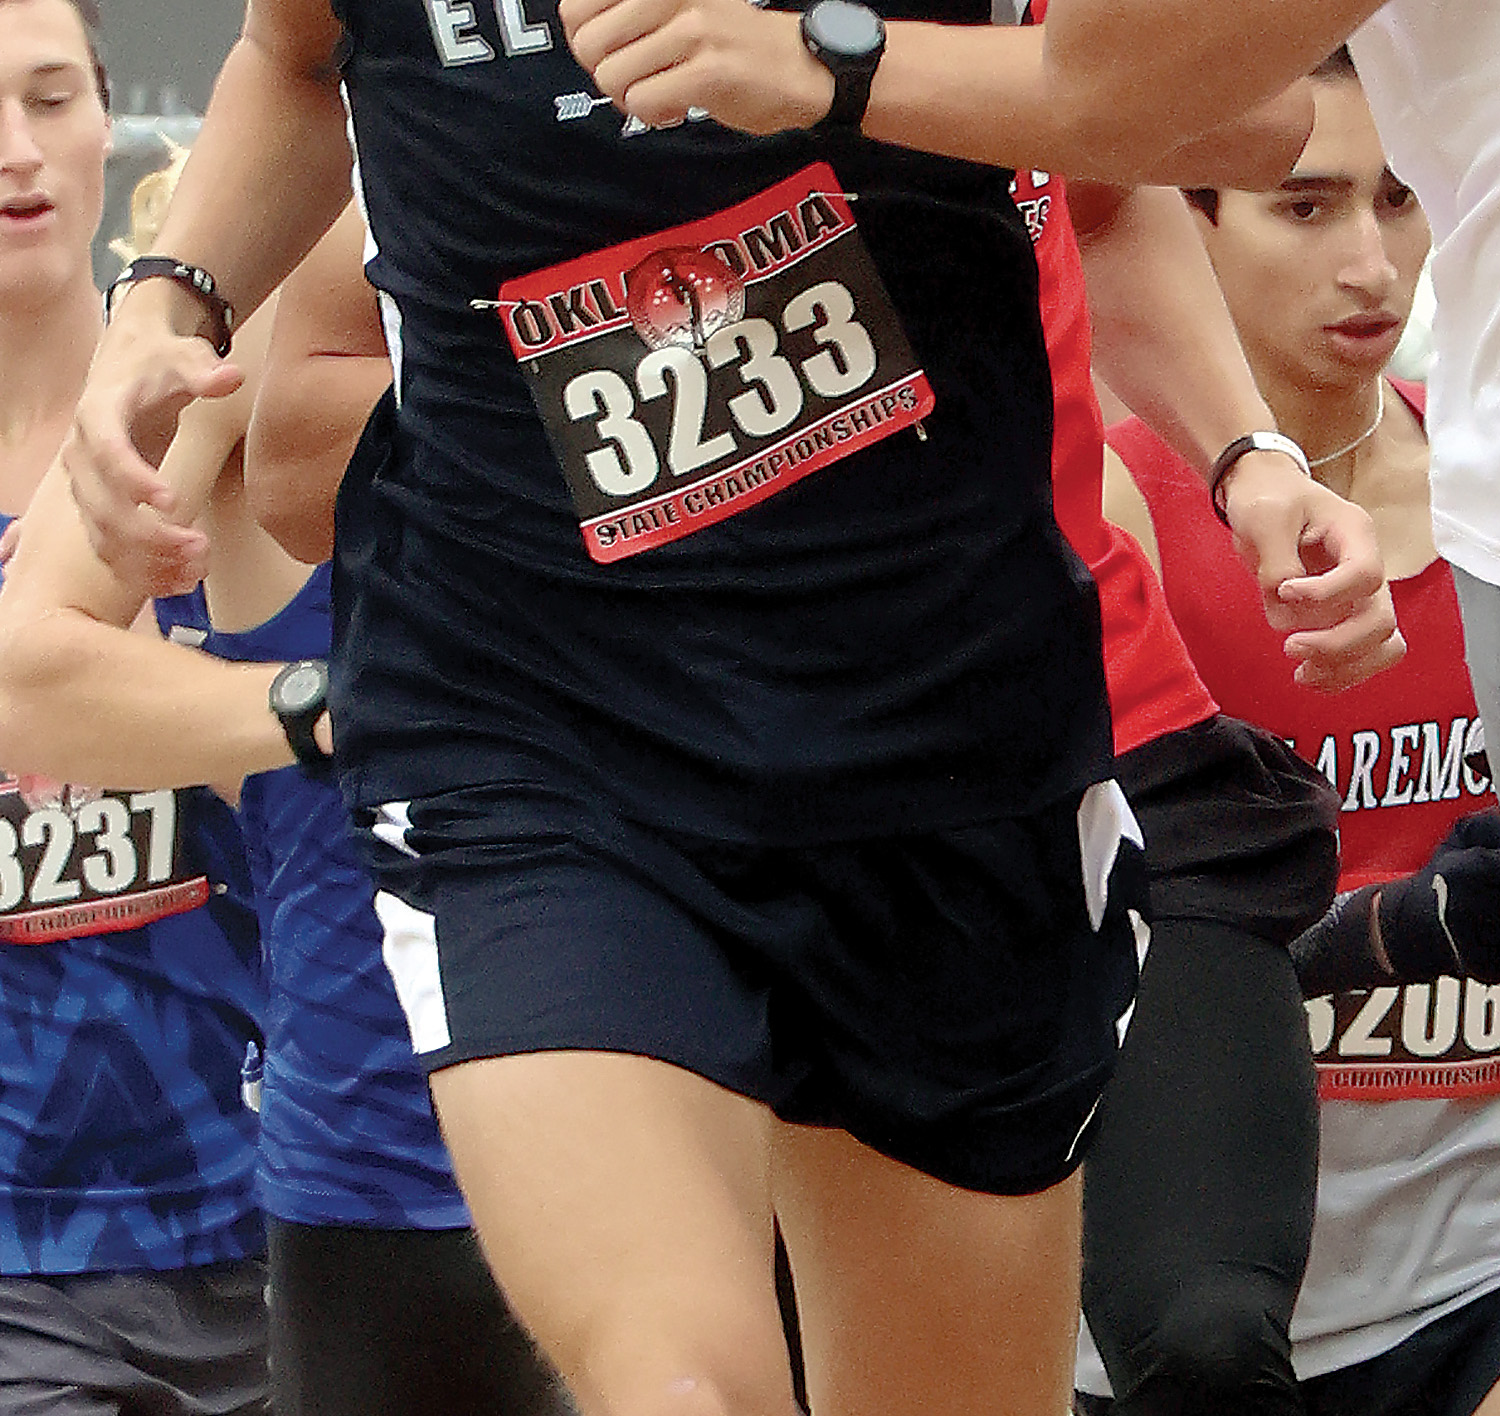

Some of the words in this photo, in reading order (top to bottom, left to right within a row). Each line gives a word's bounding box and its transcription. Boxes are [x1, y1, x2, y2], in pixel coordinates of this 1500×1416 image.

[510, 192, 847, 347] OKLOMA
[563, 281, 878, 496] 3233
[594, 499, 680, 547] STATE
[684, 385, 919, 515] CHAMPIONSHIPS
